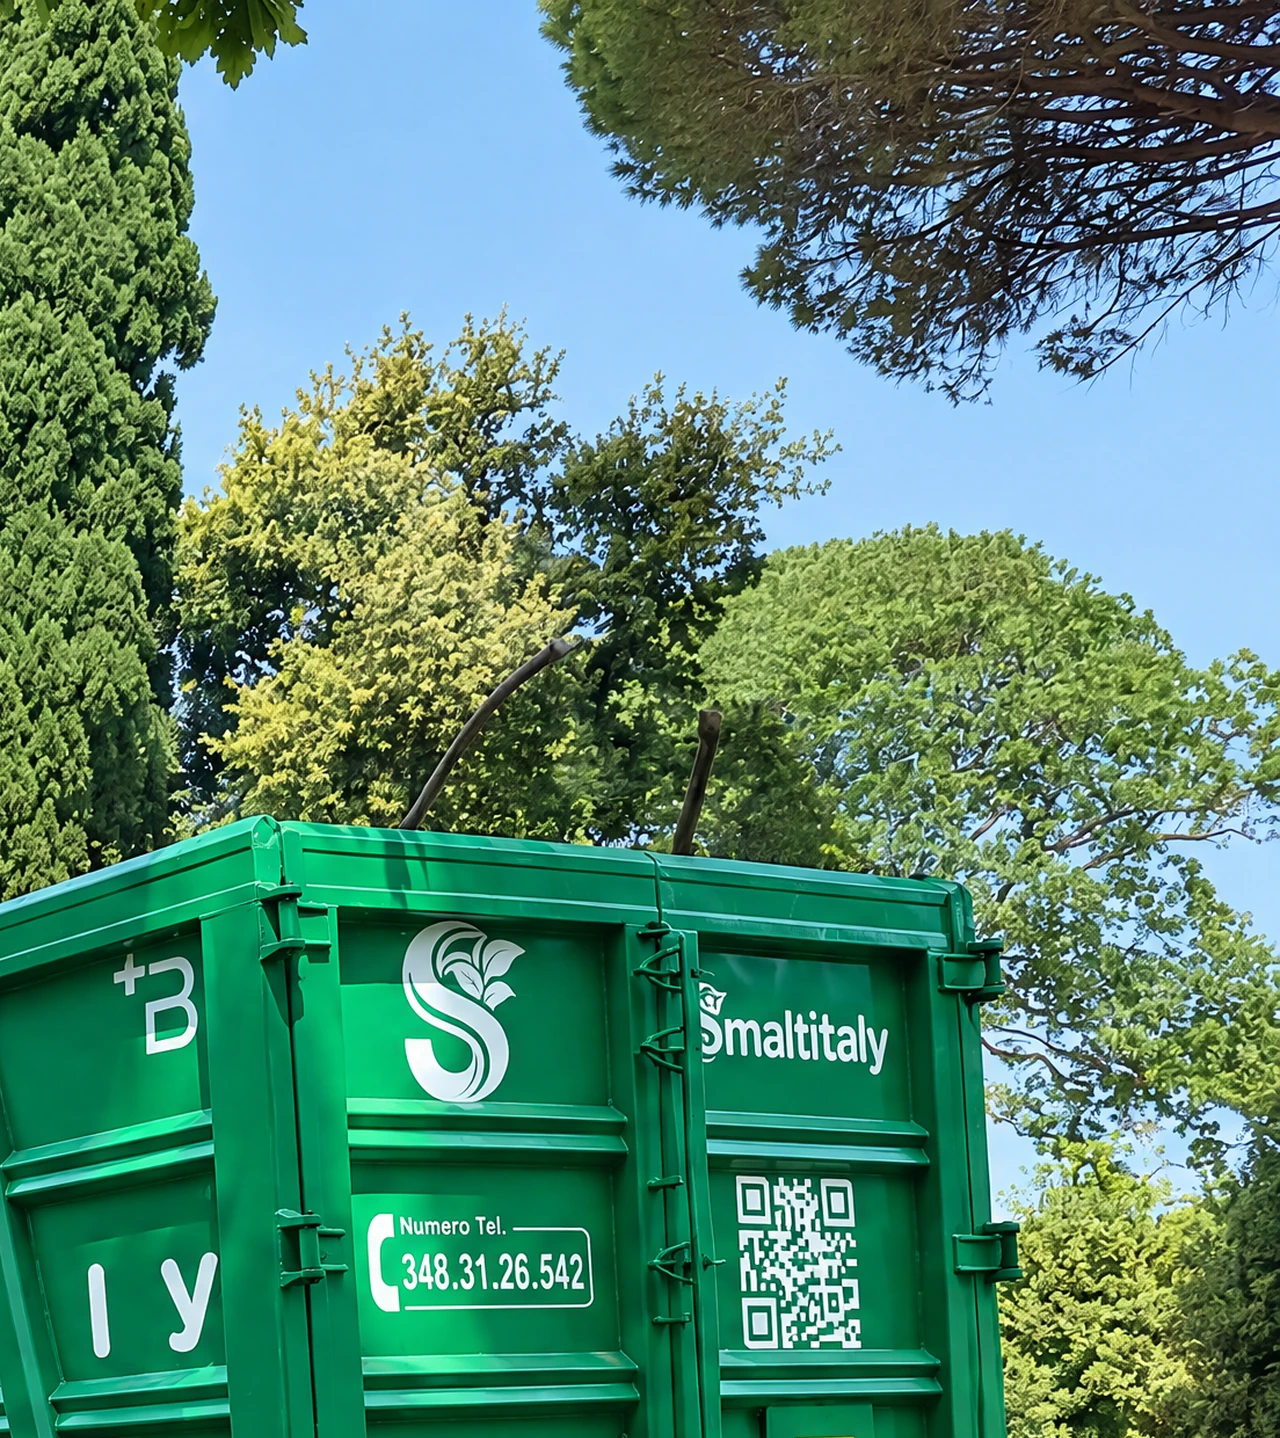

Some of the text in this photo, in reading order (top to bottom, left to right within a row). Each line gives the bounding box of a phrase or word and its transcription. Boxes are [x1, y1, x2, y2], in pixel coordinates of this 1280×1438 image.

[399, 1216, 506, 1235] Numero Tel.
[401, 1253, 585, 1290] 348.31.26.542
